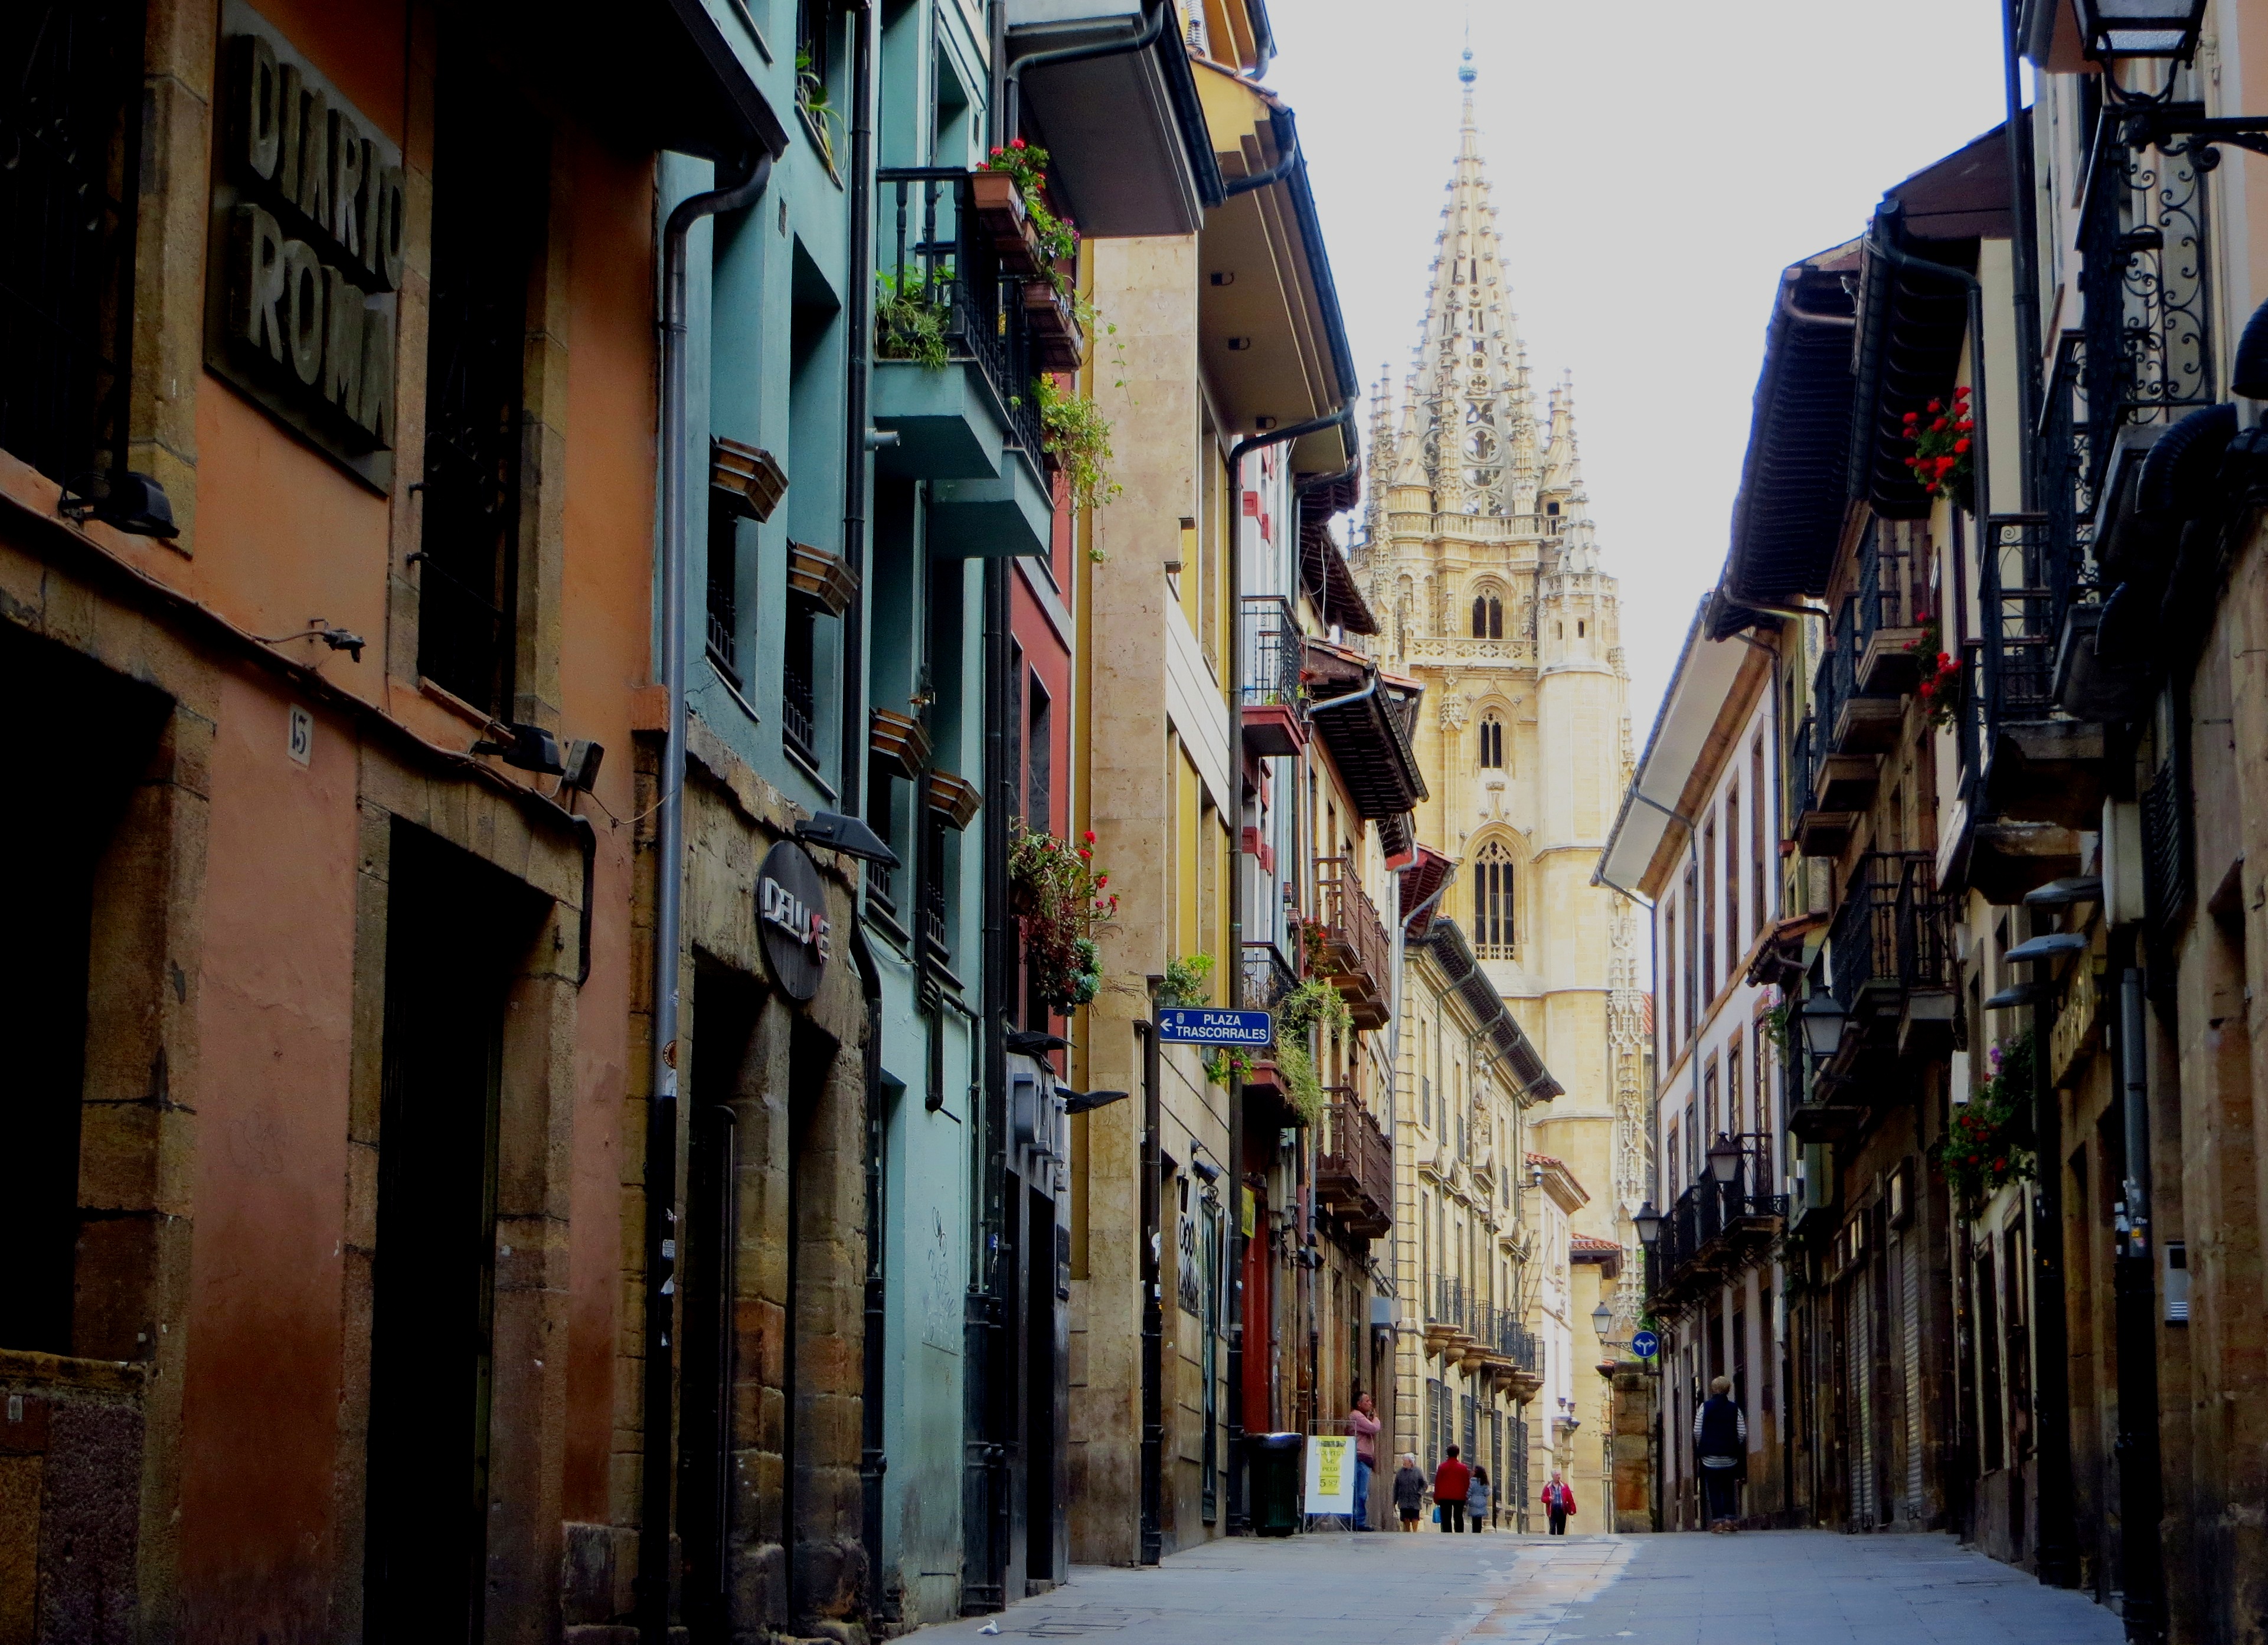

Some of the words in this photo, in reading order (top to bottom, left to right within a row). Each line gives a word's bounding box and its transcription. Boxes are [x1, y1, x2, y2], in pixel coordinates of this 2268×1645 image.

[234, 34, 406, 292] DIARIO
[233, 202, 394, 451] ROMA
[764, 877, 831, 964] DELUXE
[1175, 1025, 1267, 1040] TRASCORRALES
[1203, 1013, 1241, 1026] PLAZA
